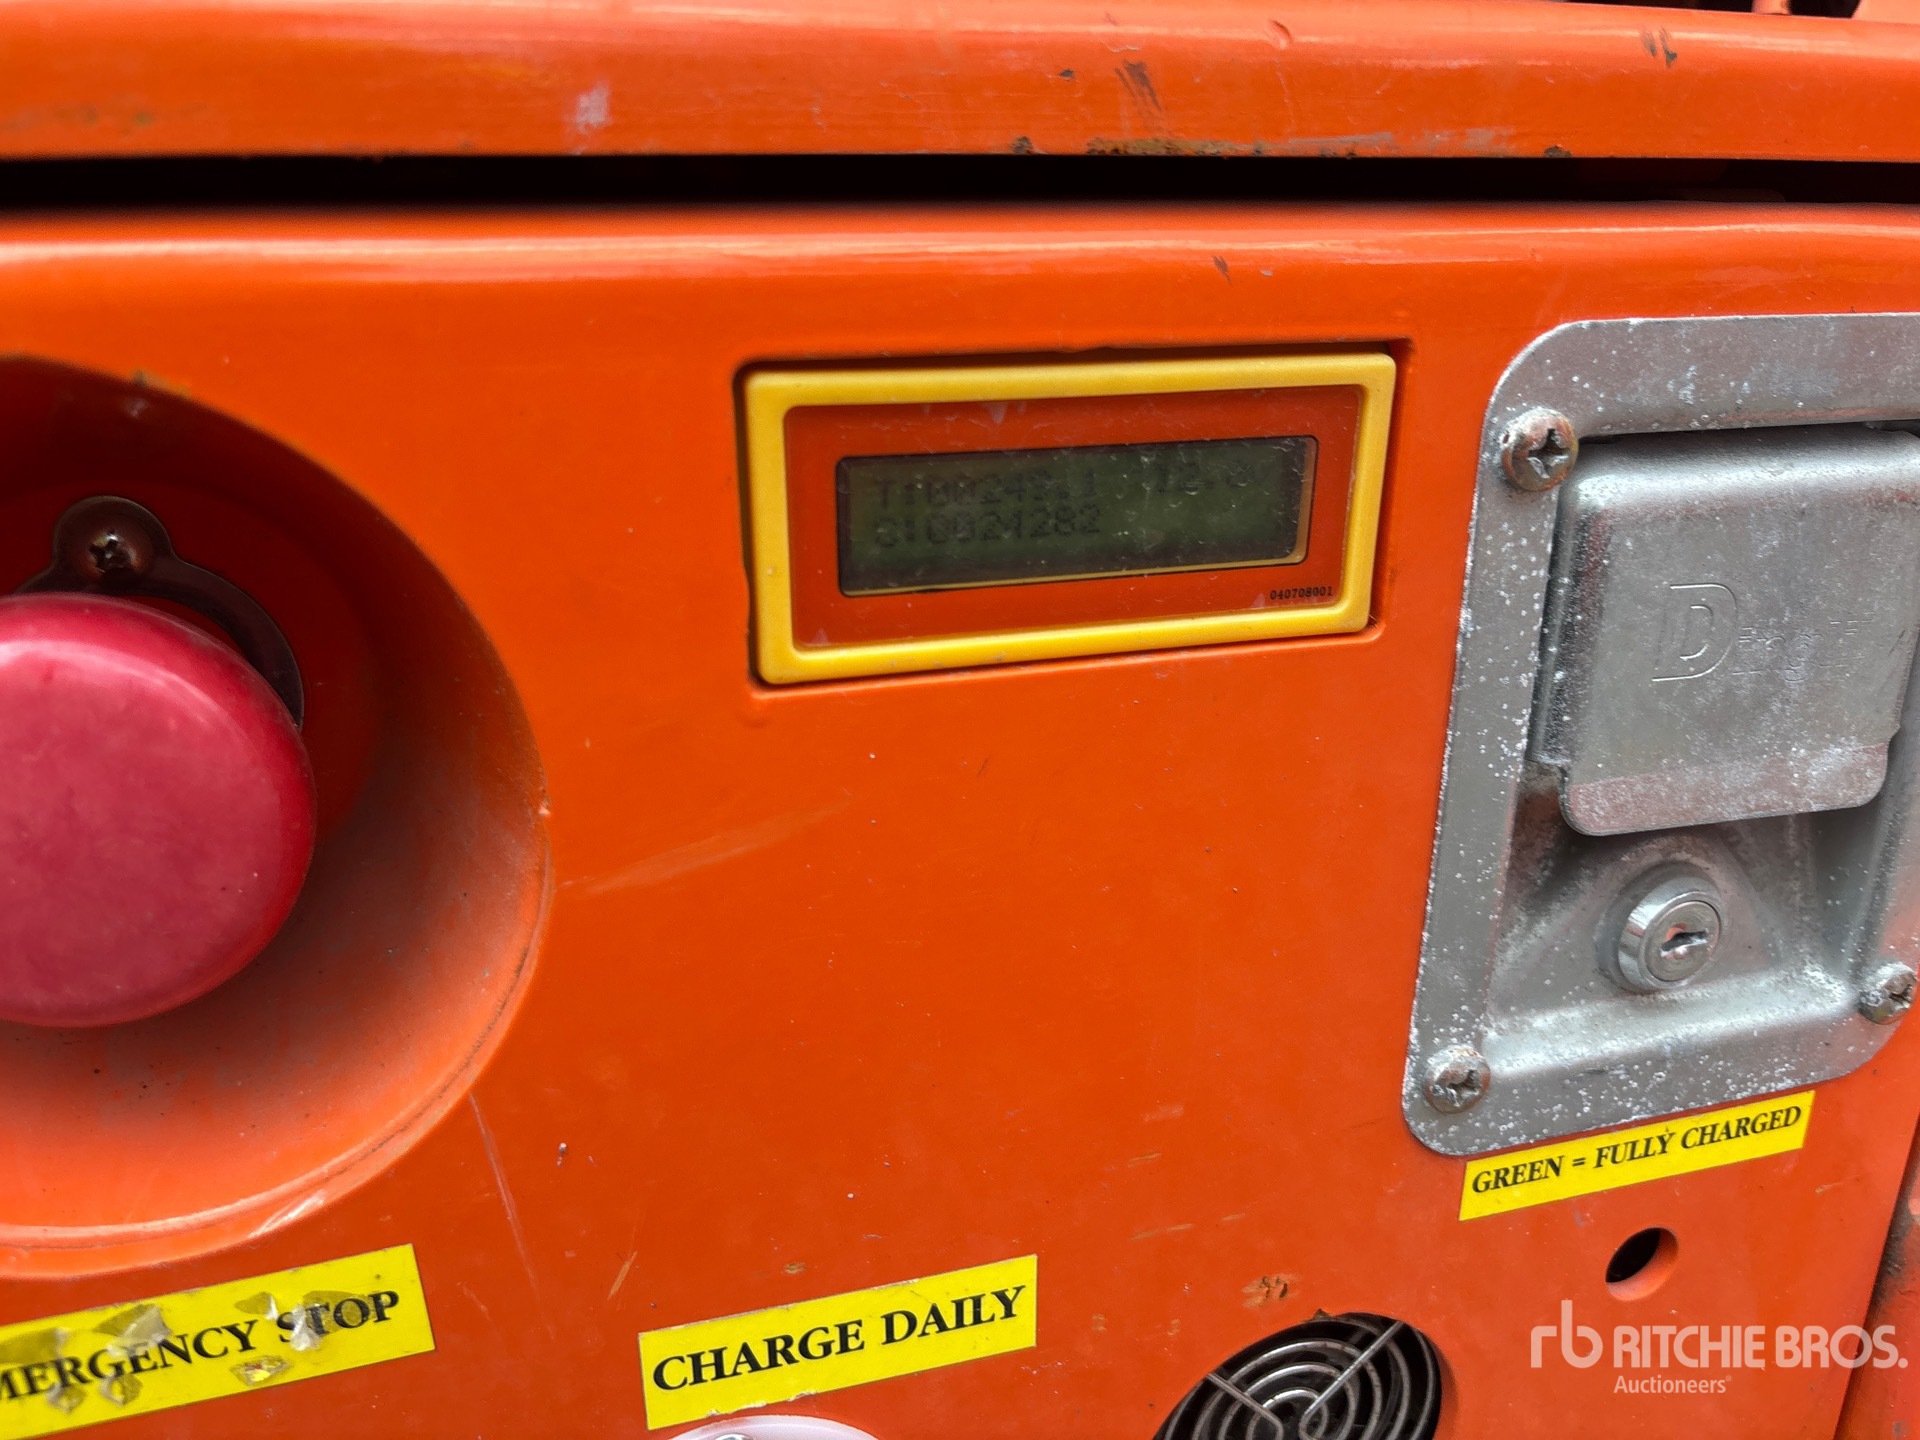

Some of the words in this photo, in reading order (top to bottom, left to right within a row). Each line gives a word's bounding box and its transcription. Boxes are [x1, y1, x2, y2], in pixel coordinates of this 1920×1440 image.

[1269, 586, 1333, 600] 040708001
[1472, 1155, 1564, 1194] GREEN
[1594, 1132, 1675, 1169] FULLY
[1681, 1105, 1801, 1150] CHARGED
[275, 1289, 400, 1344] STOP
[652, 1319, 866, 1391] CHARGE
[881, 1285, 1026, 1346] DAILY
